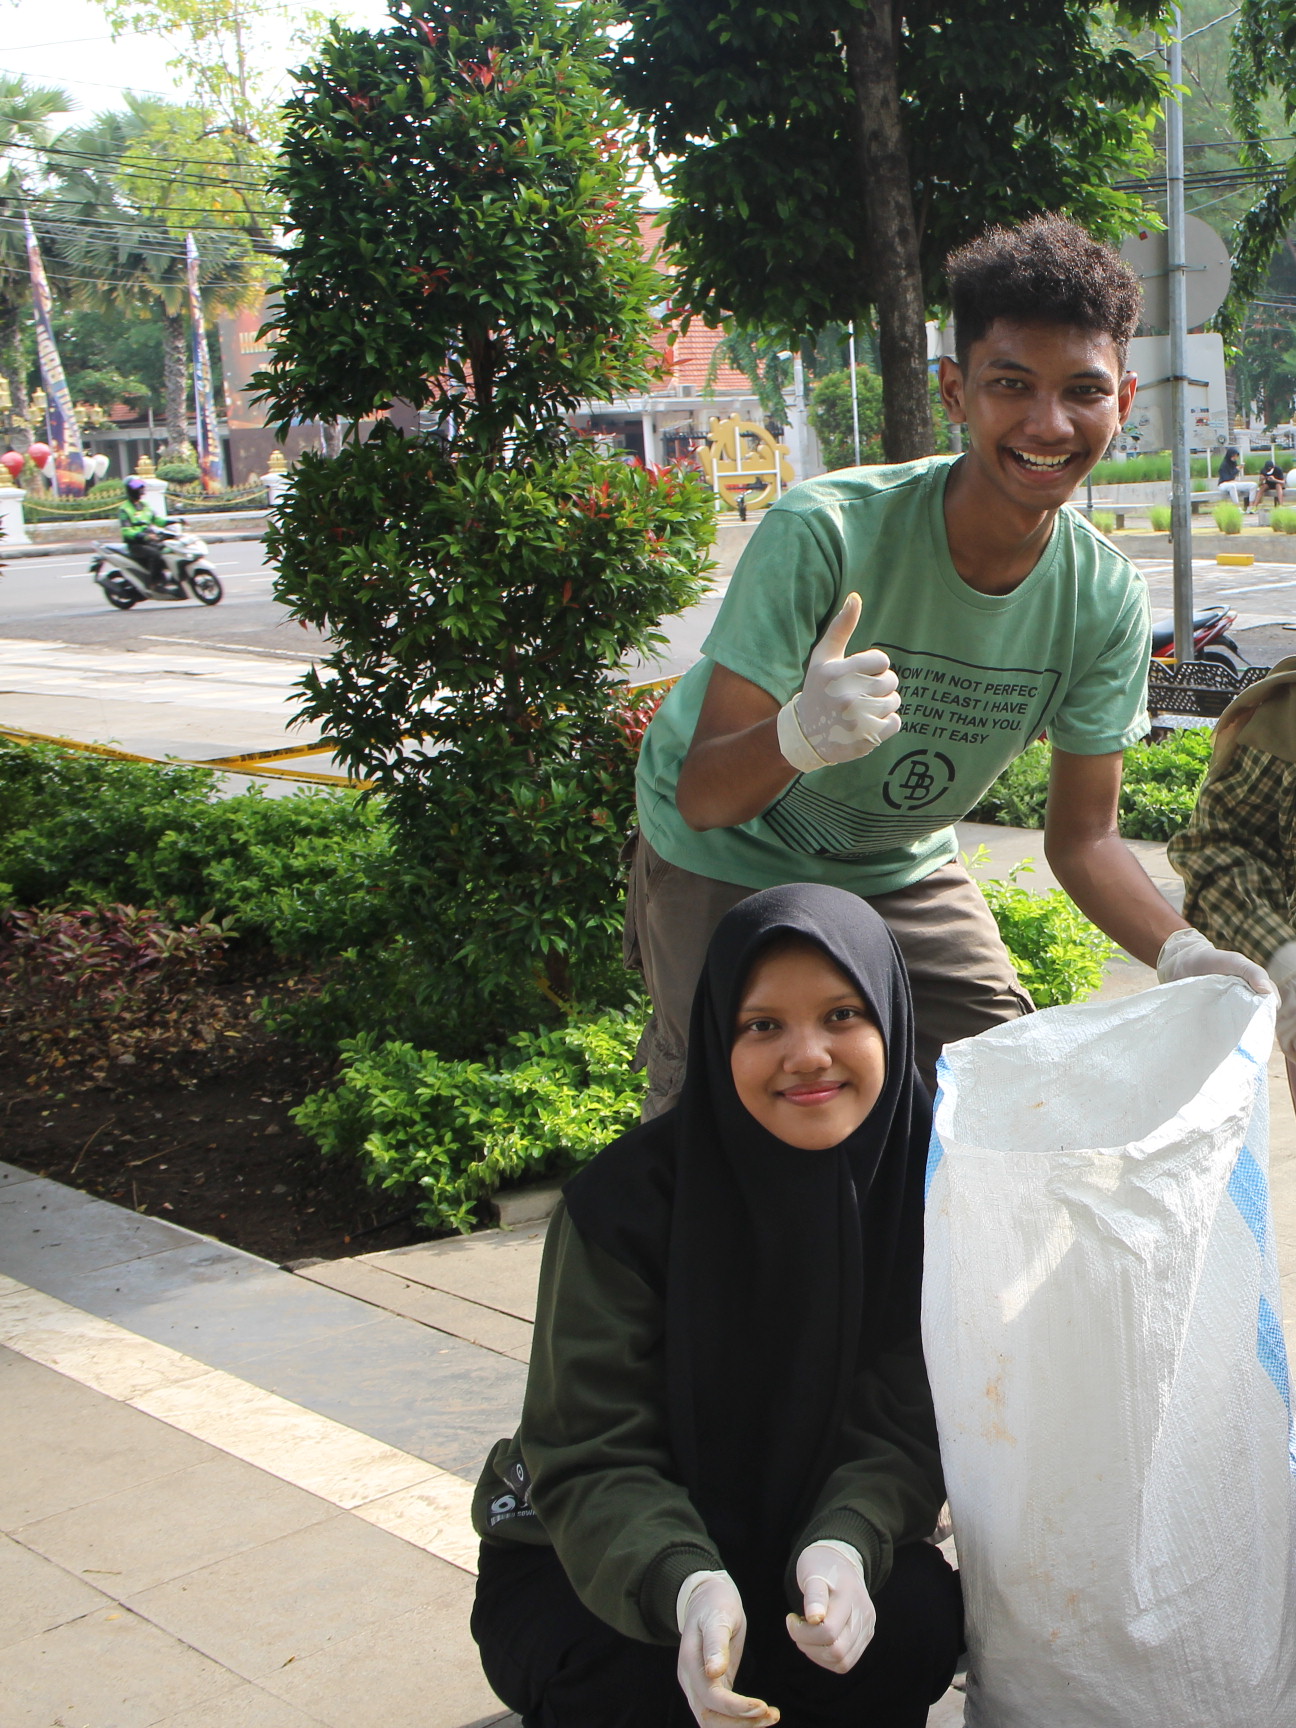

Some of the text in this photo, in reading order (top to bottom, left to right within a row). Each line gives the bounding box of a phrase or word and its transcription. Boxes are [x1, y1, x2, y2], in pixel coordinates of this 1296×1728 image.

[924, 669, 946, 684] I'M
[948, 675, 982, 692] NOT
[983, 683, 1040, 698] PERFEC
[911, 686, 929, 698] AT
[931, 690, 982, 710] LEAST
[983, 701, 989, 711] I
[991, 702, 1028, 715] HAVE
[913, 704, 944, 721] FUN
[949, 711, 988, 728] THAN
[992, 718, 1022, 731] YOU.
[900, 721, 989, 744] AKE IT EASY
